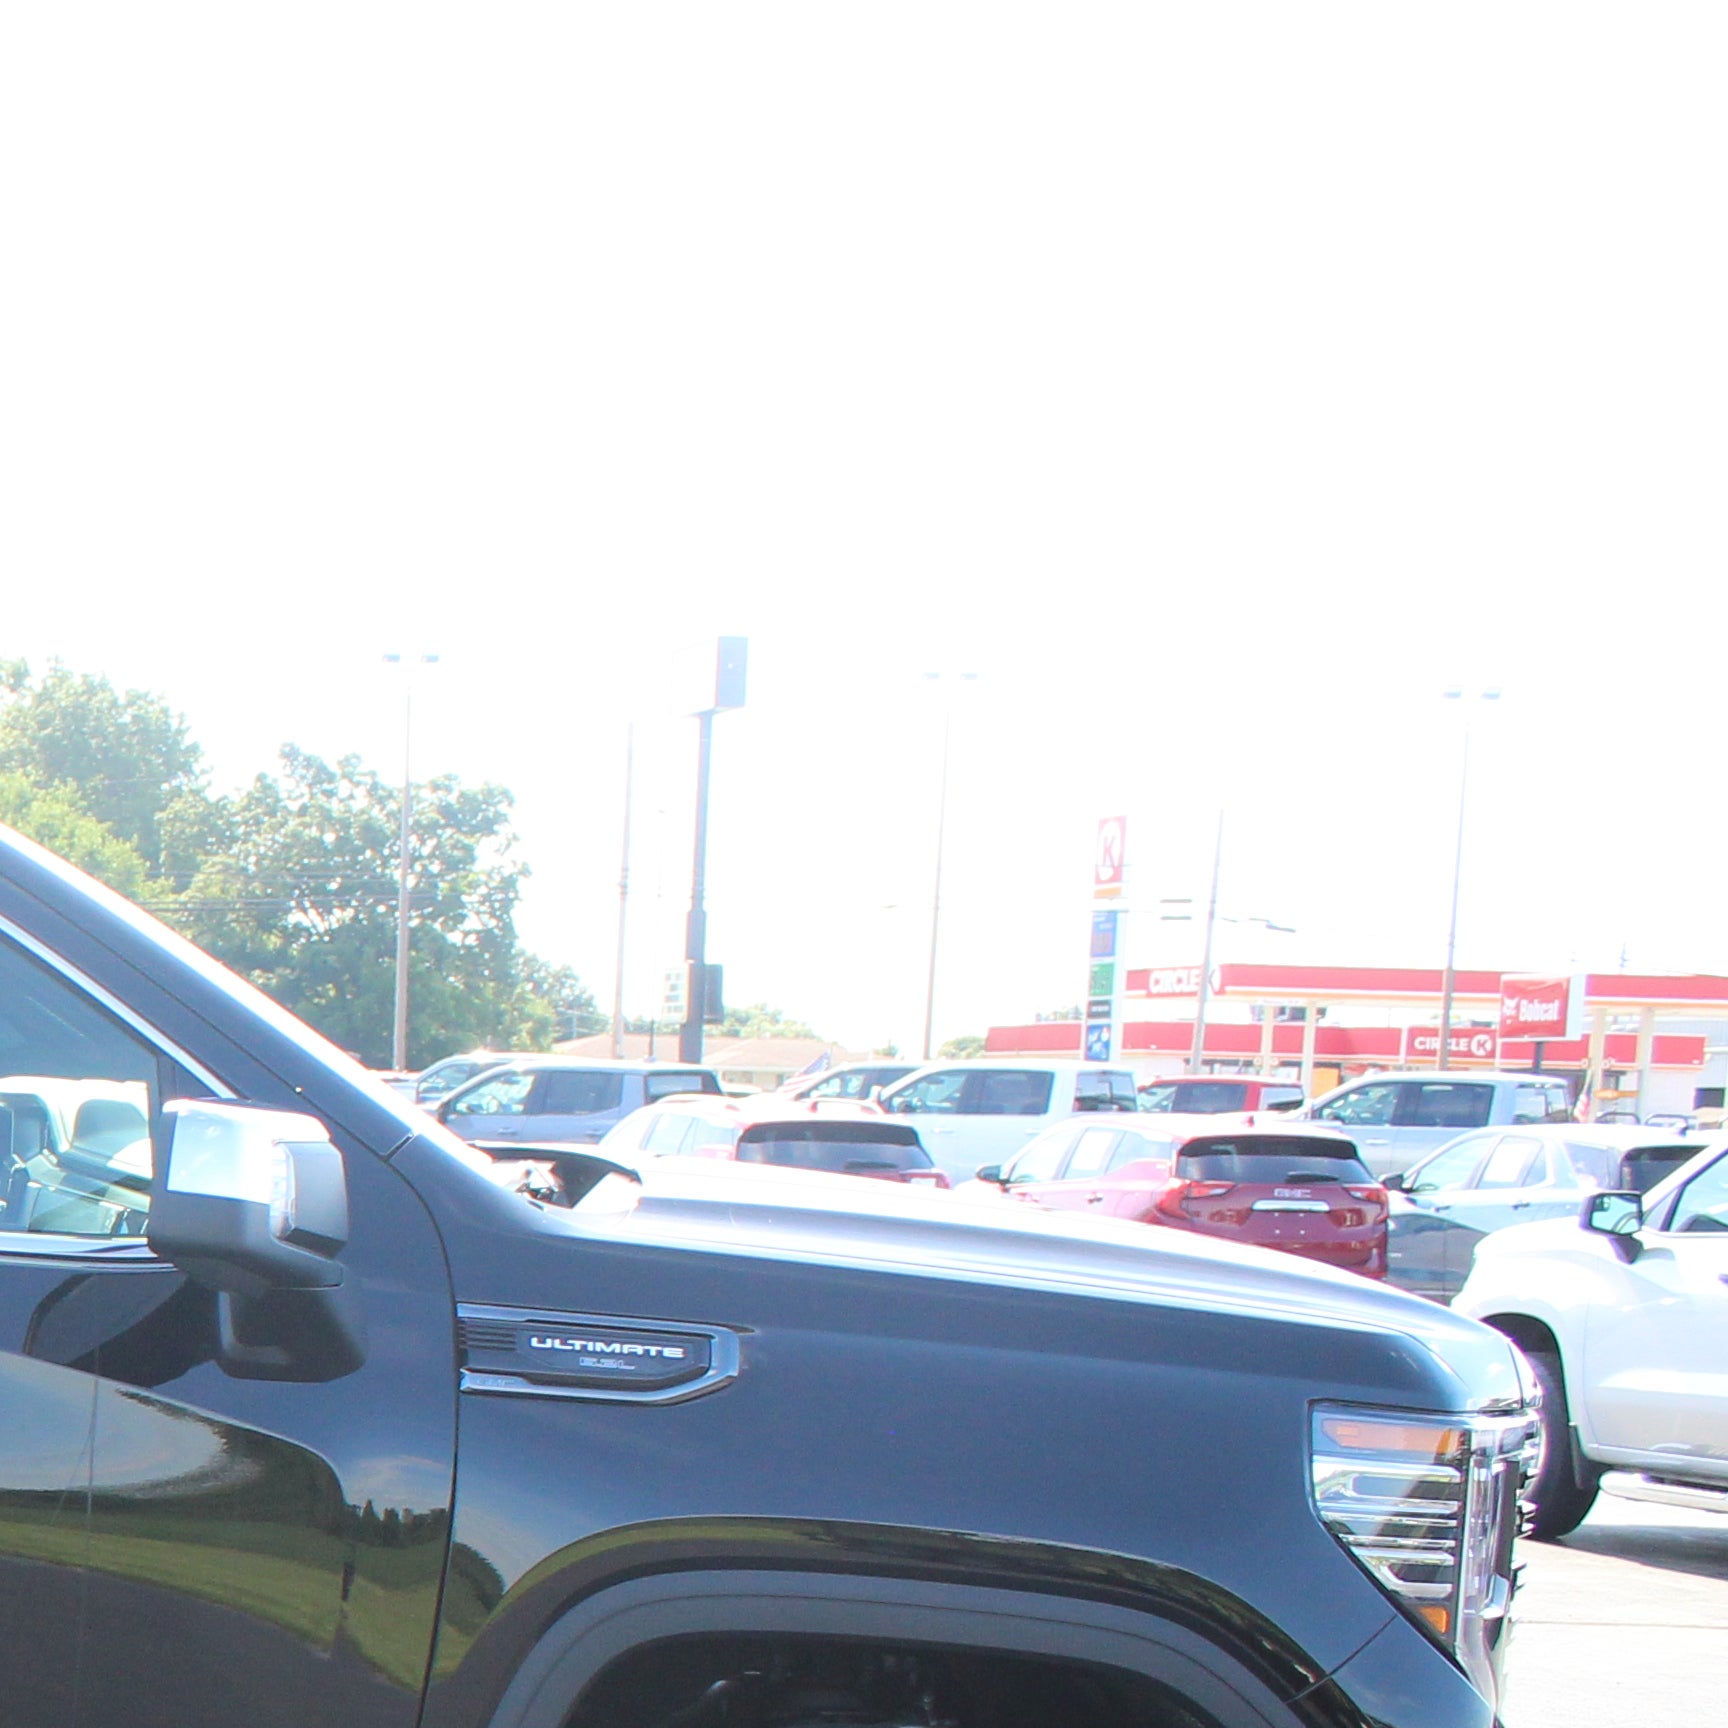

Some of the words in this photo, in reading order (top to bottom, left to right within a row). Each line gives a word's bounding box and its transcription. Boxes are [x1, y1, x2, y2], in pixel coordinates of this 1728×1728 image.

[1149, 970, 1200, 993] CIRCLE
[1519, 1000, 1560, 1022] Bobcat
[1414, 1036, 1470, 1051] CIRCLE
[529, 1336, 686, 1359] ULTIMATE
